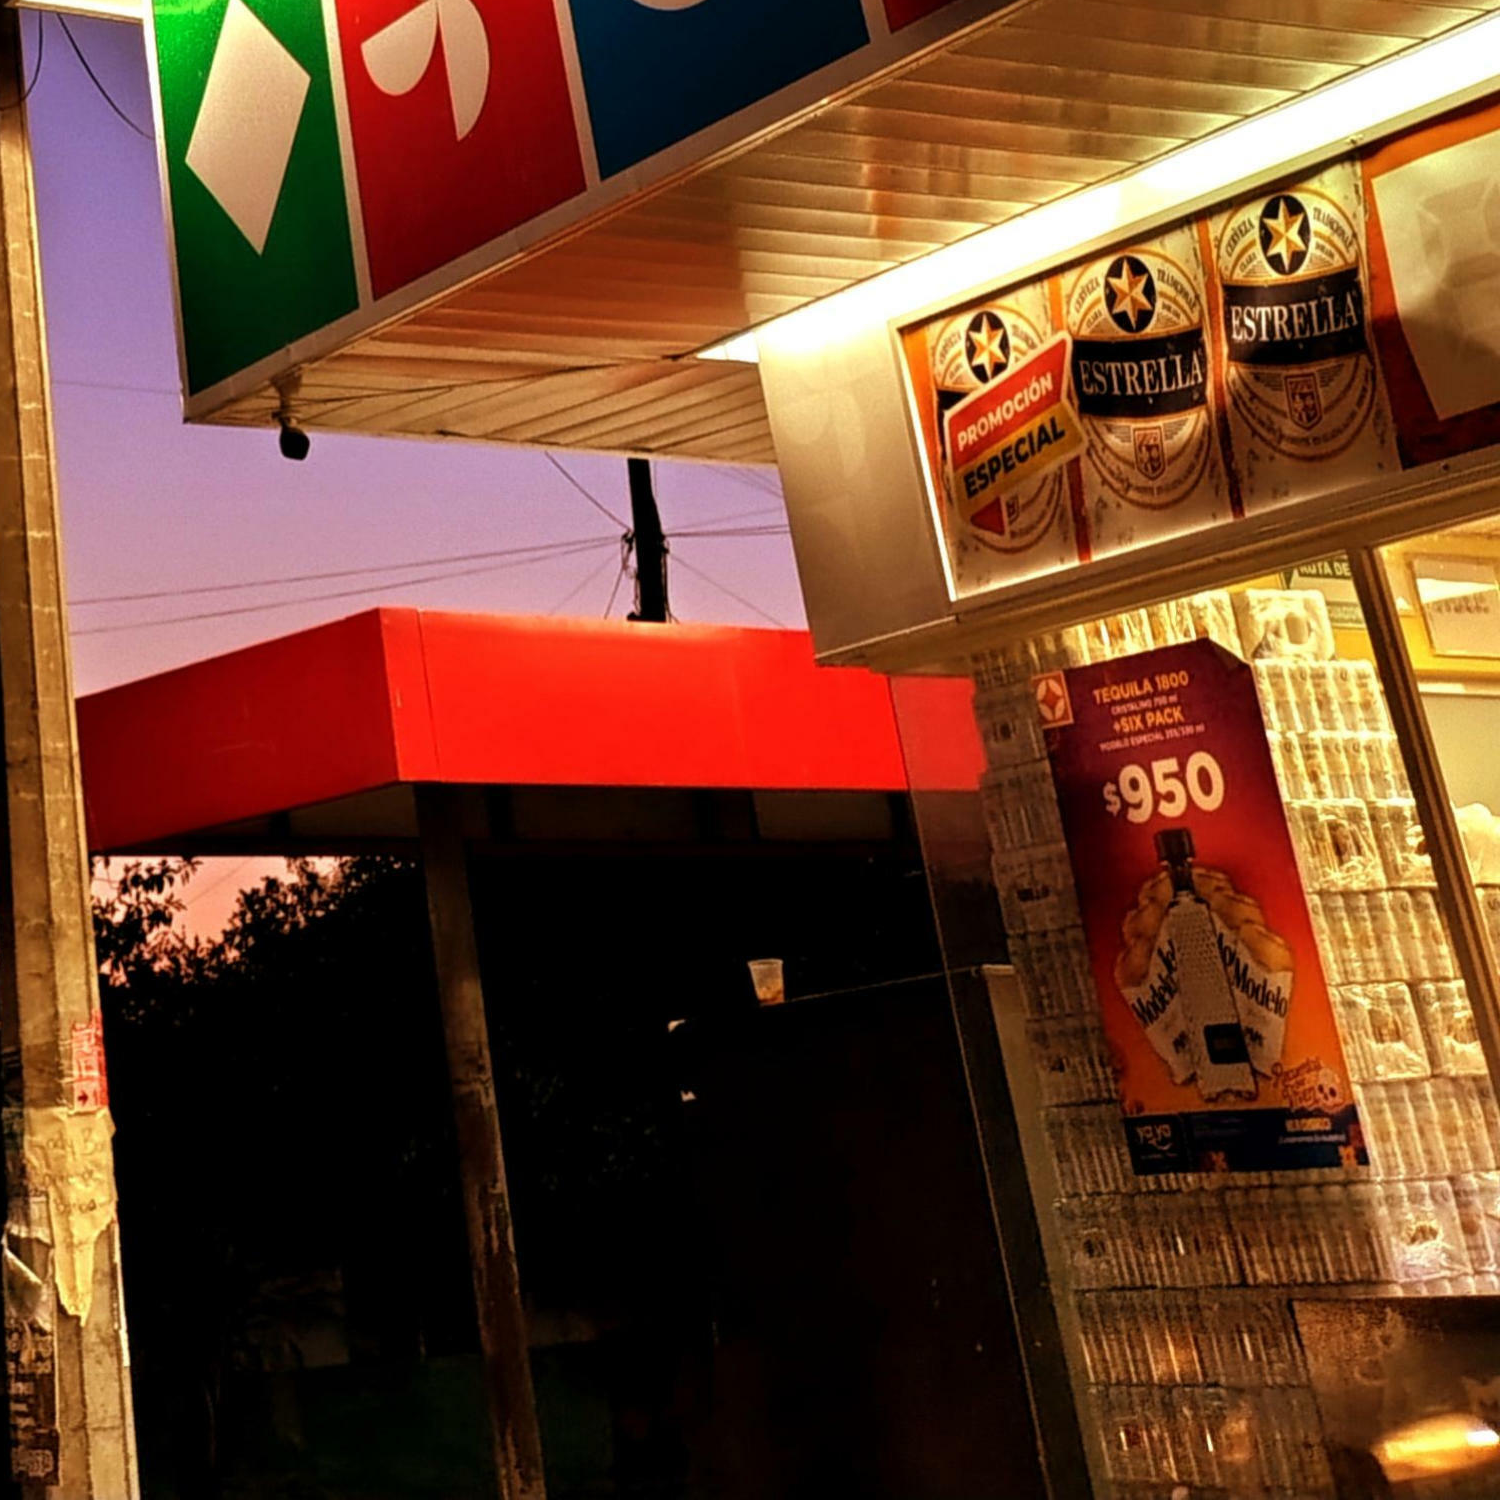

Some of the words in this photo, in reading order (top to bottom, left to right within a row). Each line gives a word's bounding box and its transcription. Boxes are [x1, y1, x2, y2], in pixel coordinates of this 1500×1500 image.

[1225, 218, 1255, 257] CERVEZA
[1074, 277, 1100, 313] CERVEZA
[1231, 292, 1358, 342] ESTRELLA
[1079, 350, 1203, 395] ESTRELLA
[957, 372, 1053, 451] PROMOCIÓN
[963, 417, 1066, 499] ESPECIAL
[1093, 678, 1154, 704] TEQUILA
[1155, 670, 1189, 691] 1800
[1145, 705, 1185, 728] PACK
[1103, 751, 1224, 824] $950
[1234, 956, 1288, 1018] Modelo
